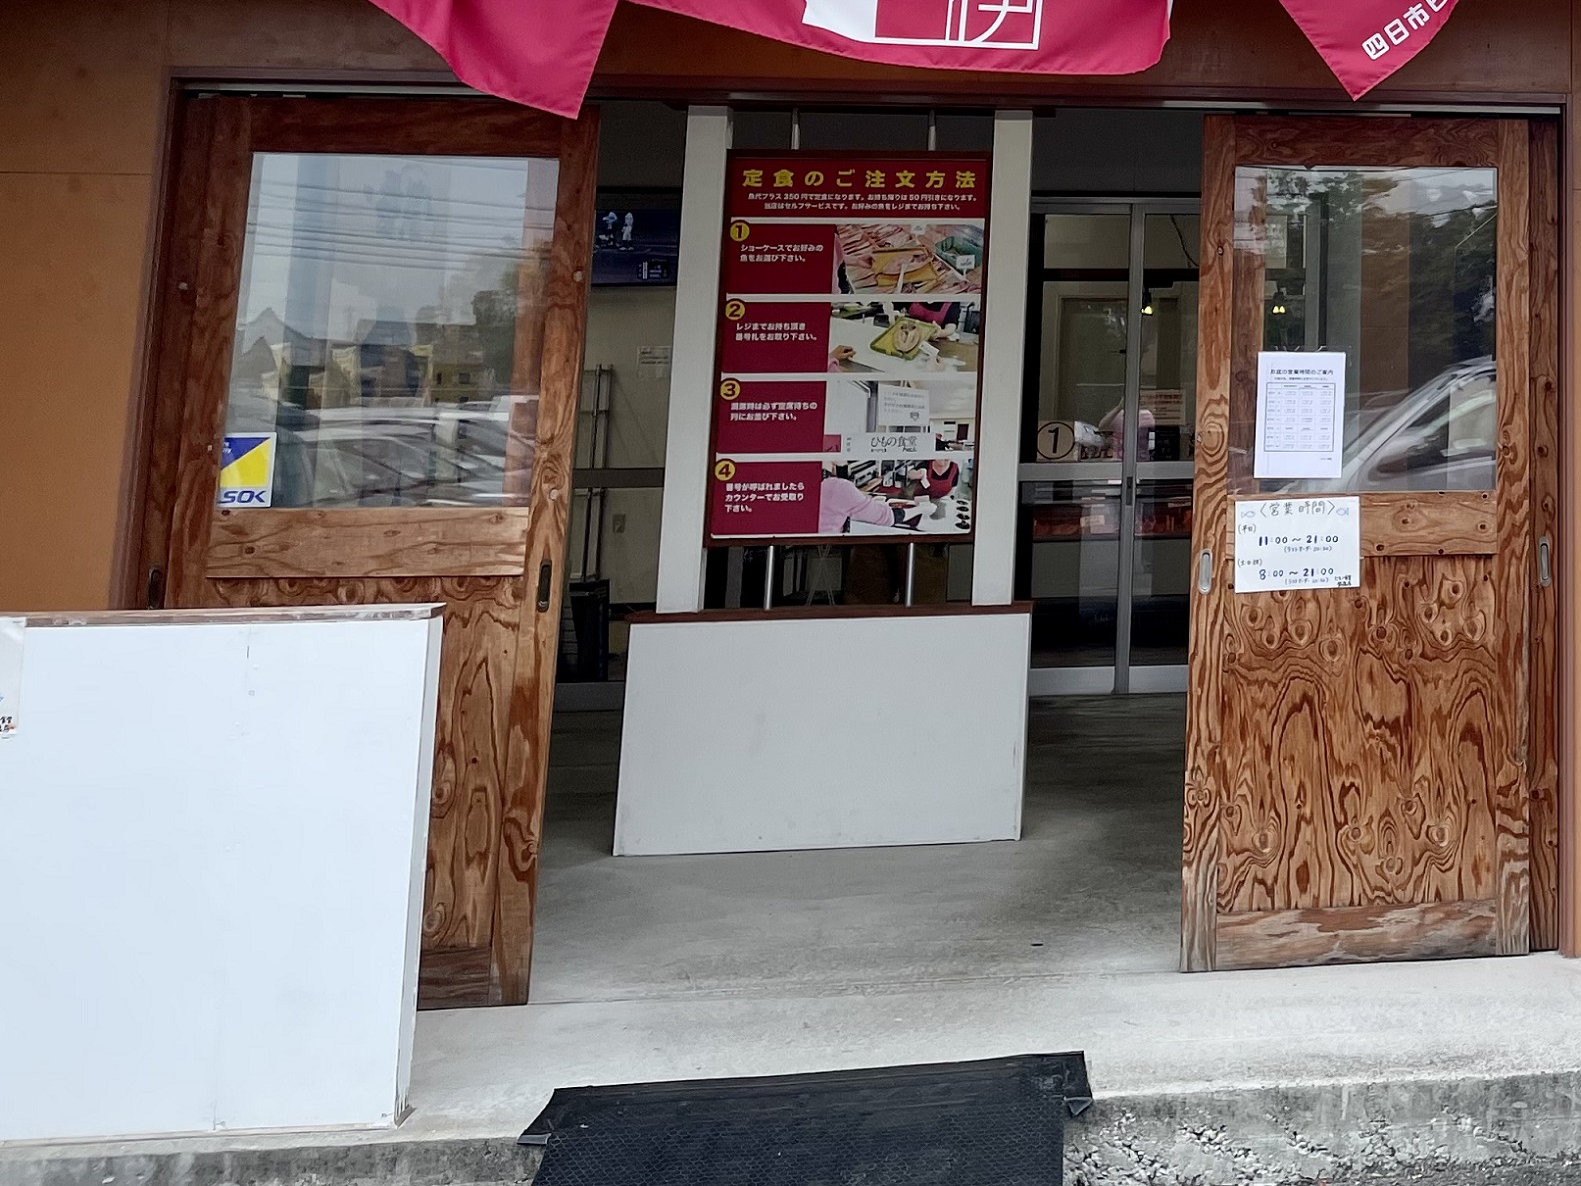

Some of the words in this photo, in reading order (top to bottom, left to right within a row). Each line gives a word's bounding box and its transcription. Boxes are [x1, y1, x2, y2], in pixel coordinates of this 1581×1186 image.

[742, 169, 977, 189] 定食のご注文方法
